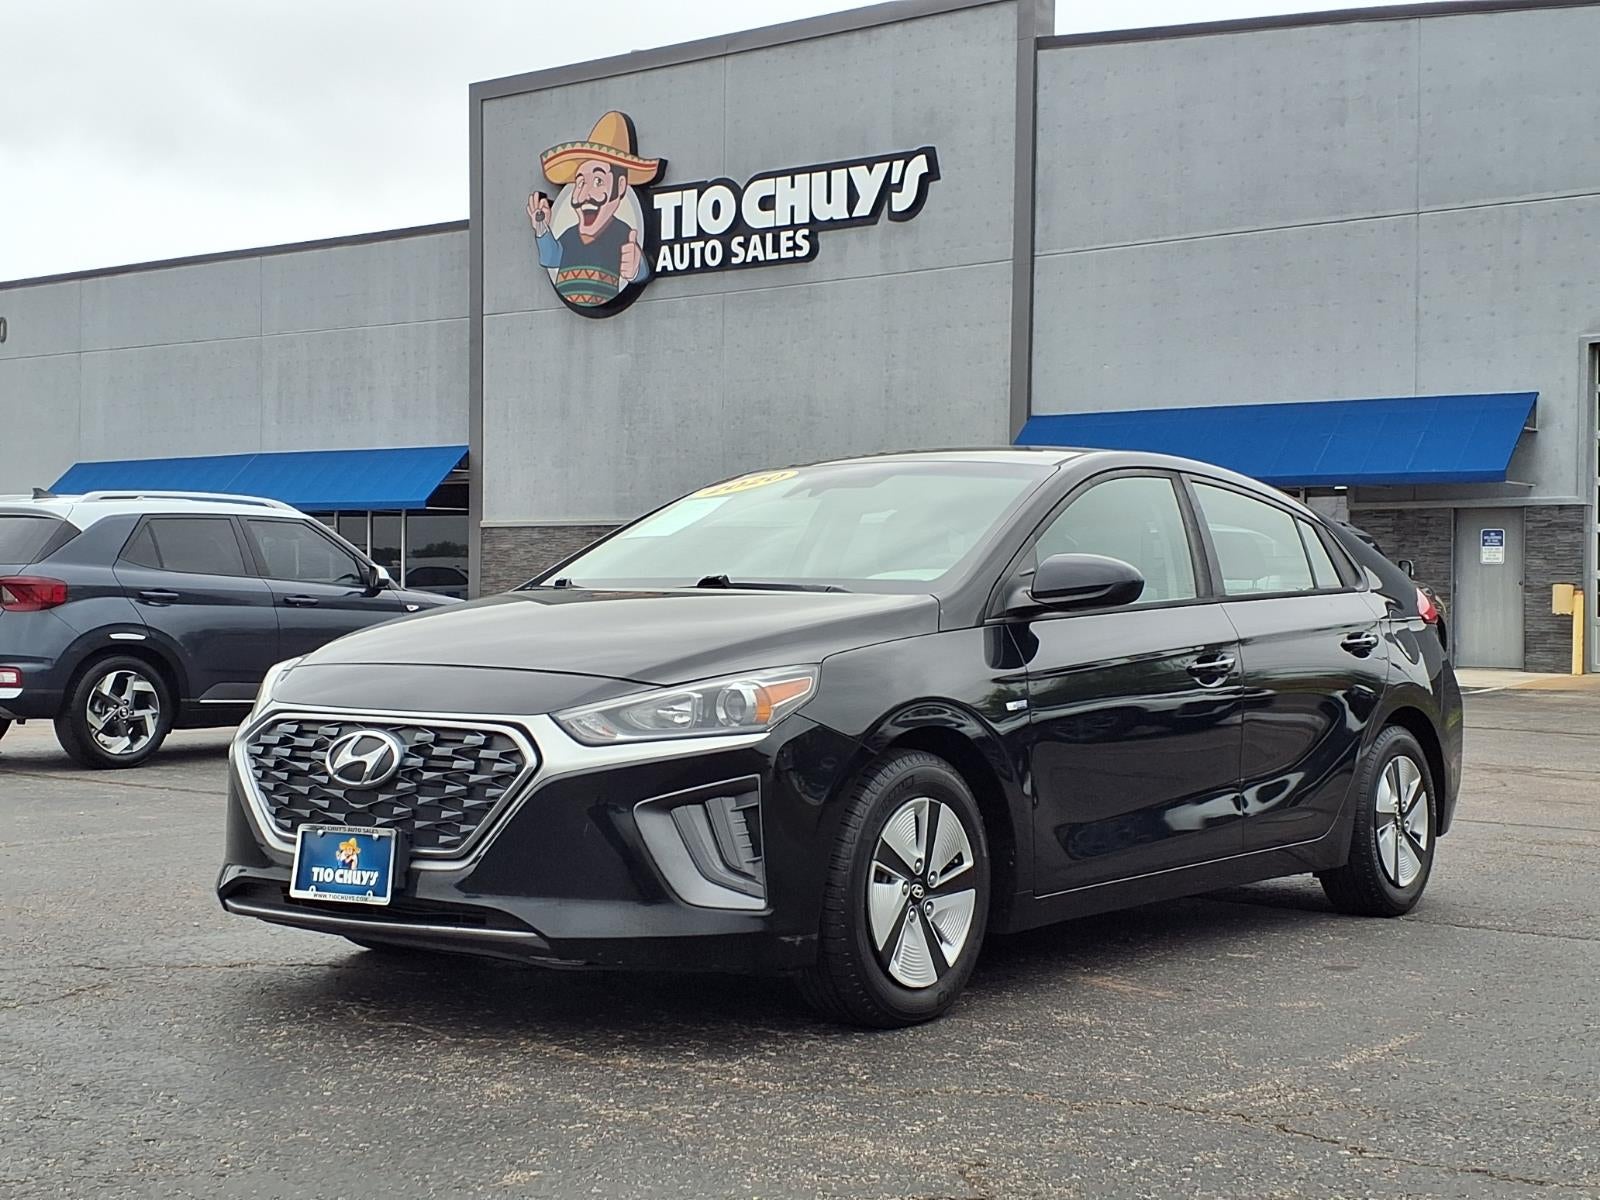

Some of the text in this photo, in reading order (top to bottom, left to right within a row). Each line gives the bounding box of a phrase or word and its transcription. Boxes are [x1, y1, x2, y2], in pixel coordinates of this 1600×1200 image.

[653, 154, 929, 241] TIO CHUY'S
[655, 228, 811, 273] AUTO SALES
[311, 866, 379, 886] TIO CHUY'S
